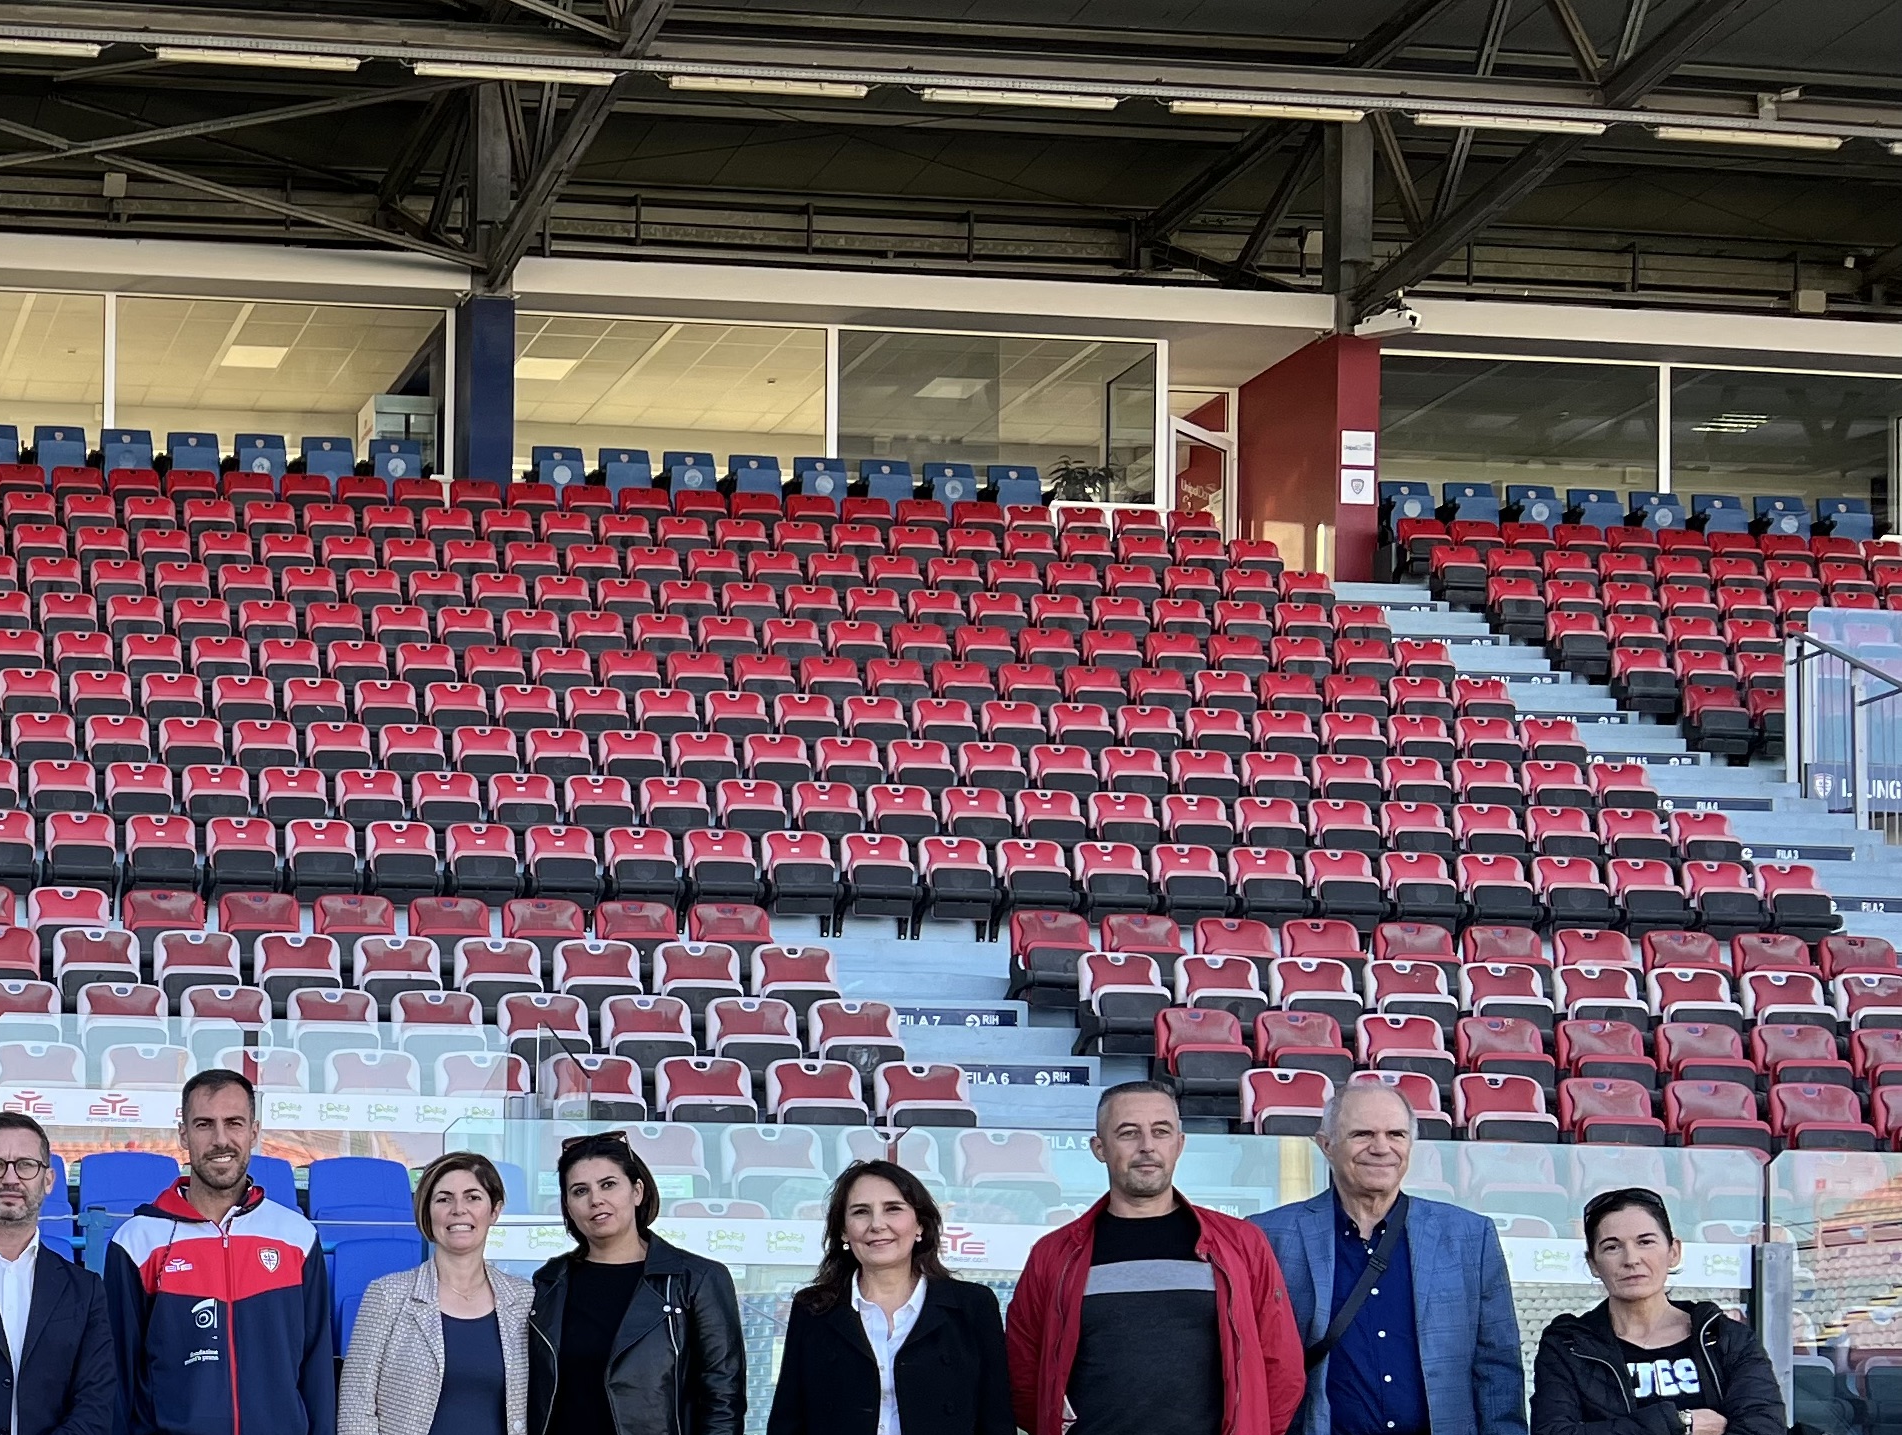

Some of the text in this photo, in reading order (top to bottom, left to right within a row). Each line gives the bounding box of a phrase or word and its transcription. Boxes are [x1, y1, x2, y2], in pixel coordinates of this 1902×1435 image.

[898, 1015, 941, 1026] FILA 7
[982, 1015, 999, 1025] RIH
[967, 1072, 1010, 1085] FILA 6
[1052, 1072, 1070, 1082] RIH
[1081, 1137, 1089, 1149] 5
